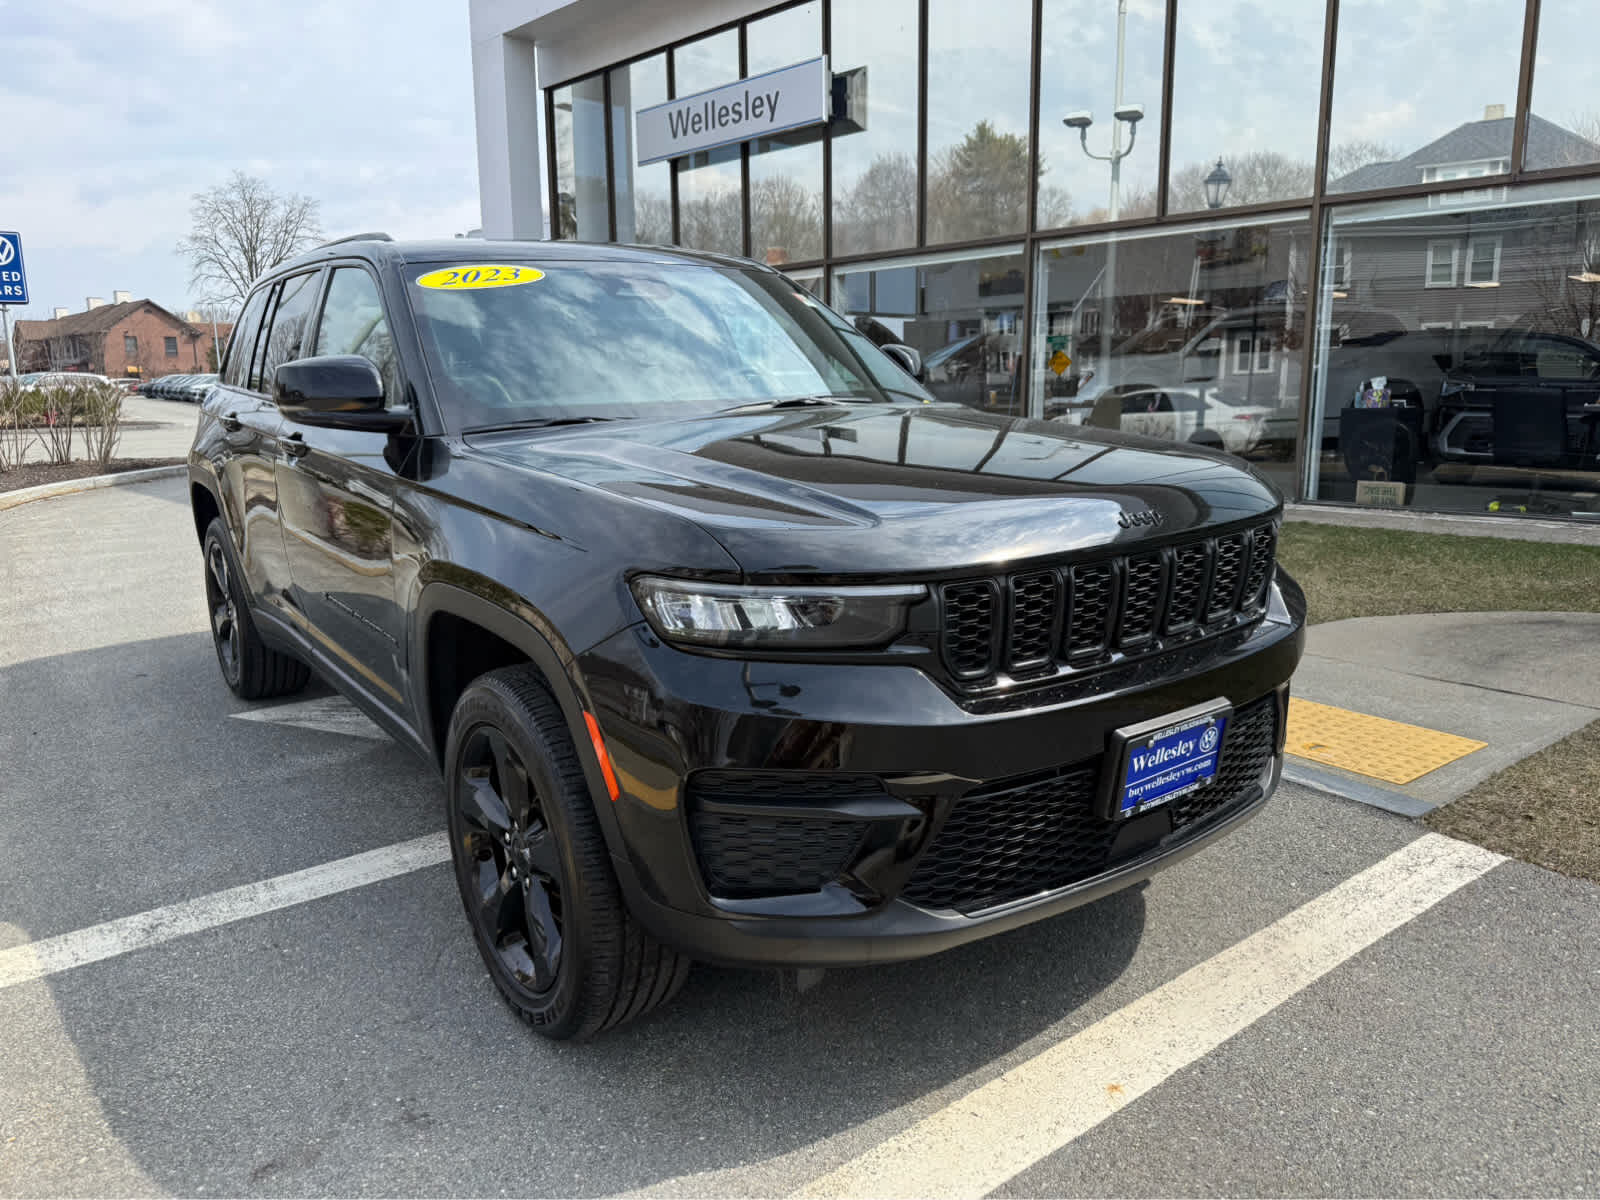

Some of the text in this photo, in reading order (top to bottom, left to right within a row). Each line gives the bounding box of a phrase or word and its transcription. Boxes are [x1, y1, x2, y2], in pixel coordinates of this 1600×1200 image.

[668, 90, 780, 139] Wellesley
[441, 267, 520, 285] 2023
[1132, 740, 1195, 773] Wellesley
